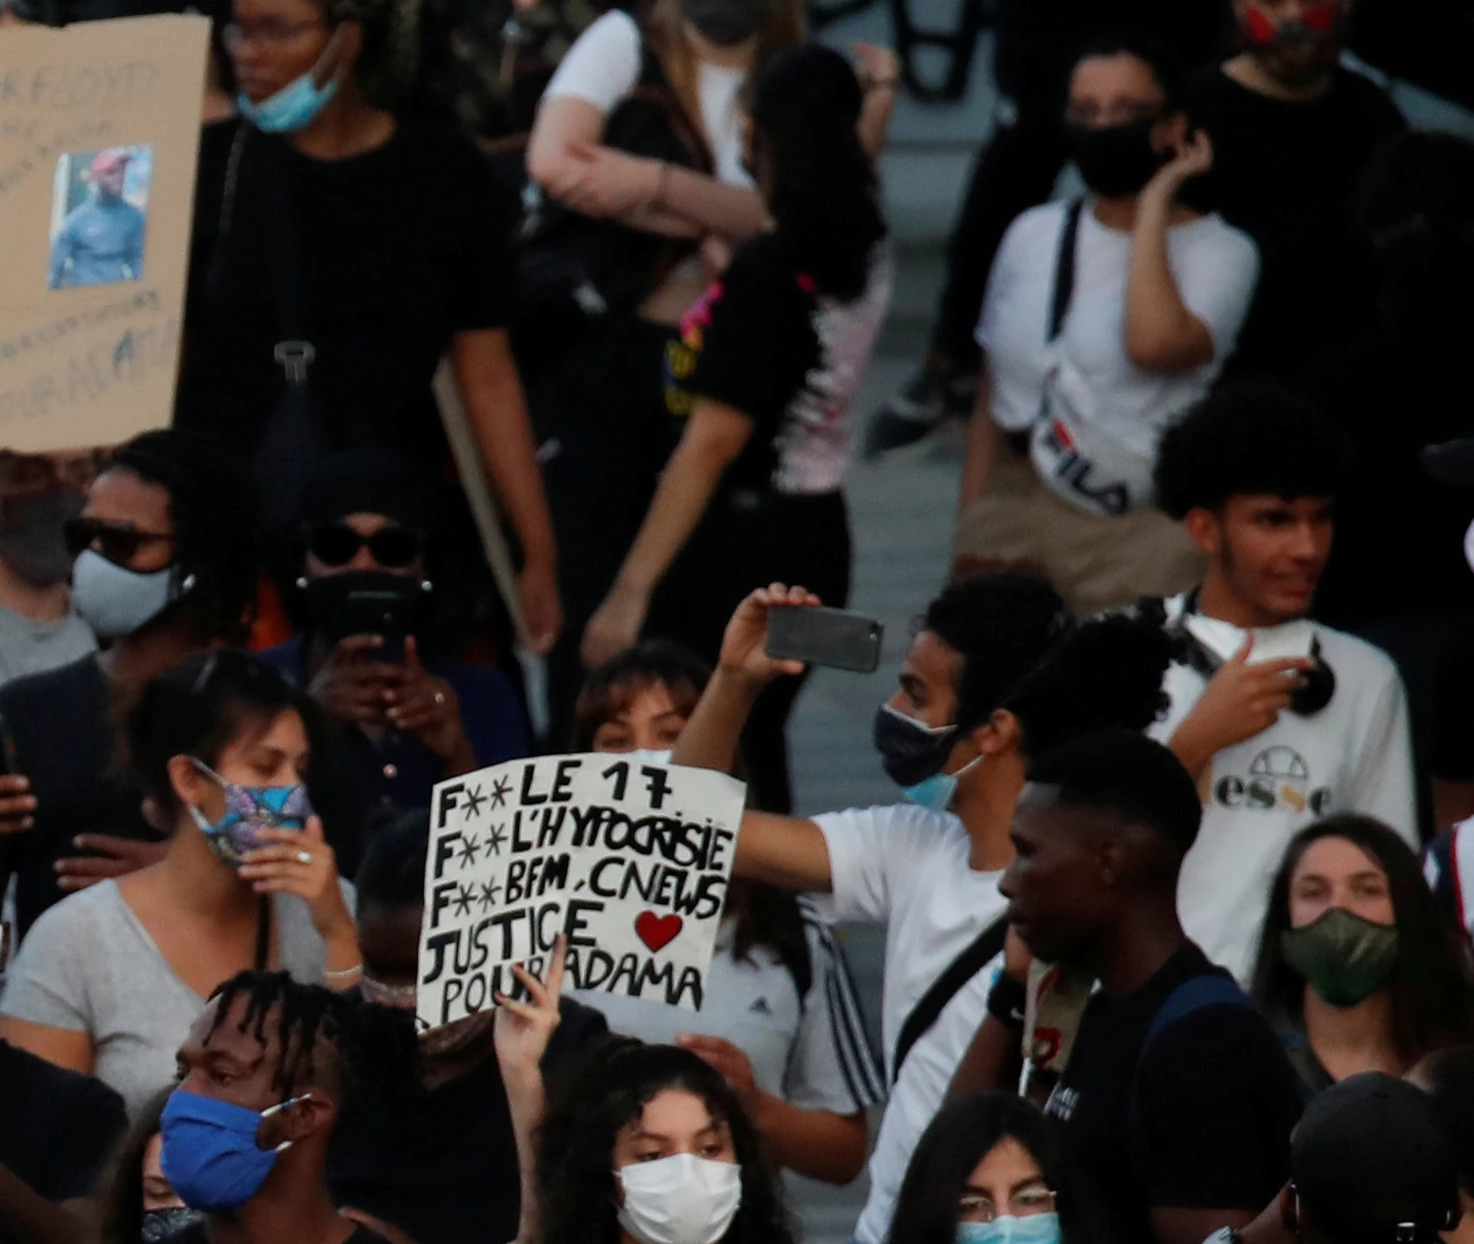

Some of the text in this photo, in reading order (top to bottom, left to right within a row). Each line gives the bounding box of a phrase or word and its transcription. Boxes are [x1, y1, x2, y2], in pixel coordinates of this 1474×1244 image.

[1044, 419, 1129, 515] FILA
[519, 760, 582, 806] LE
[601, 761, 673, 809] 17
[510, 805, 734, 871] L'HYPOCRISIE
[589, 855, 728, 921] CNEWS
[422, 898, 605, 985] JUSTICE
[441, 949, 704, 1024] POUR ADAMA
